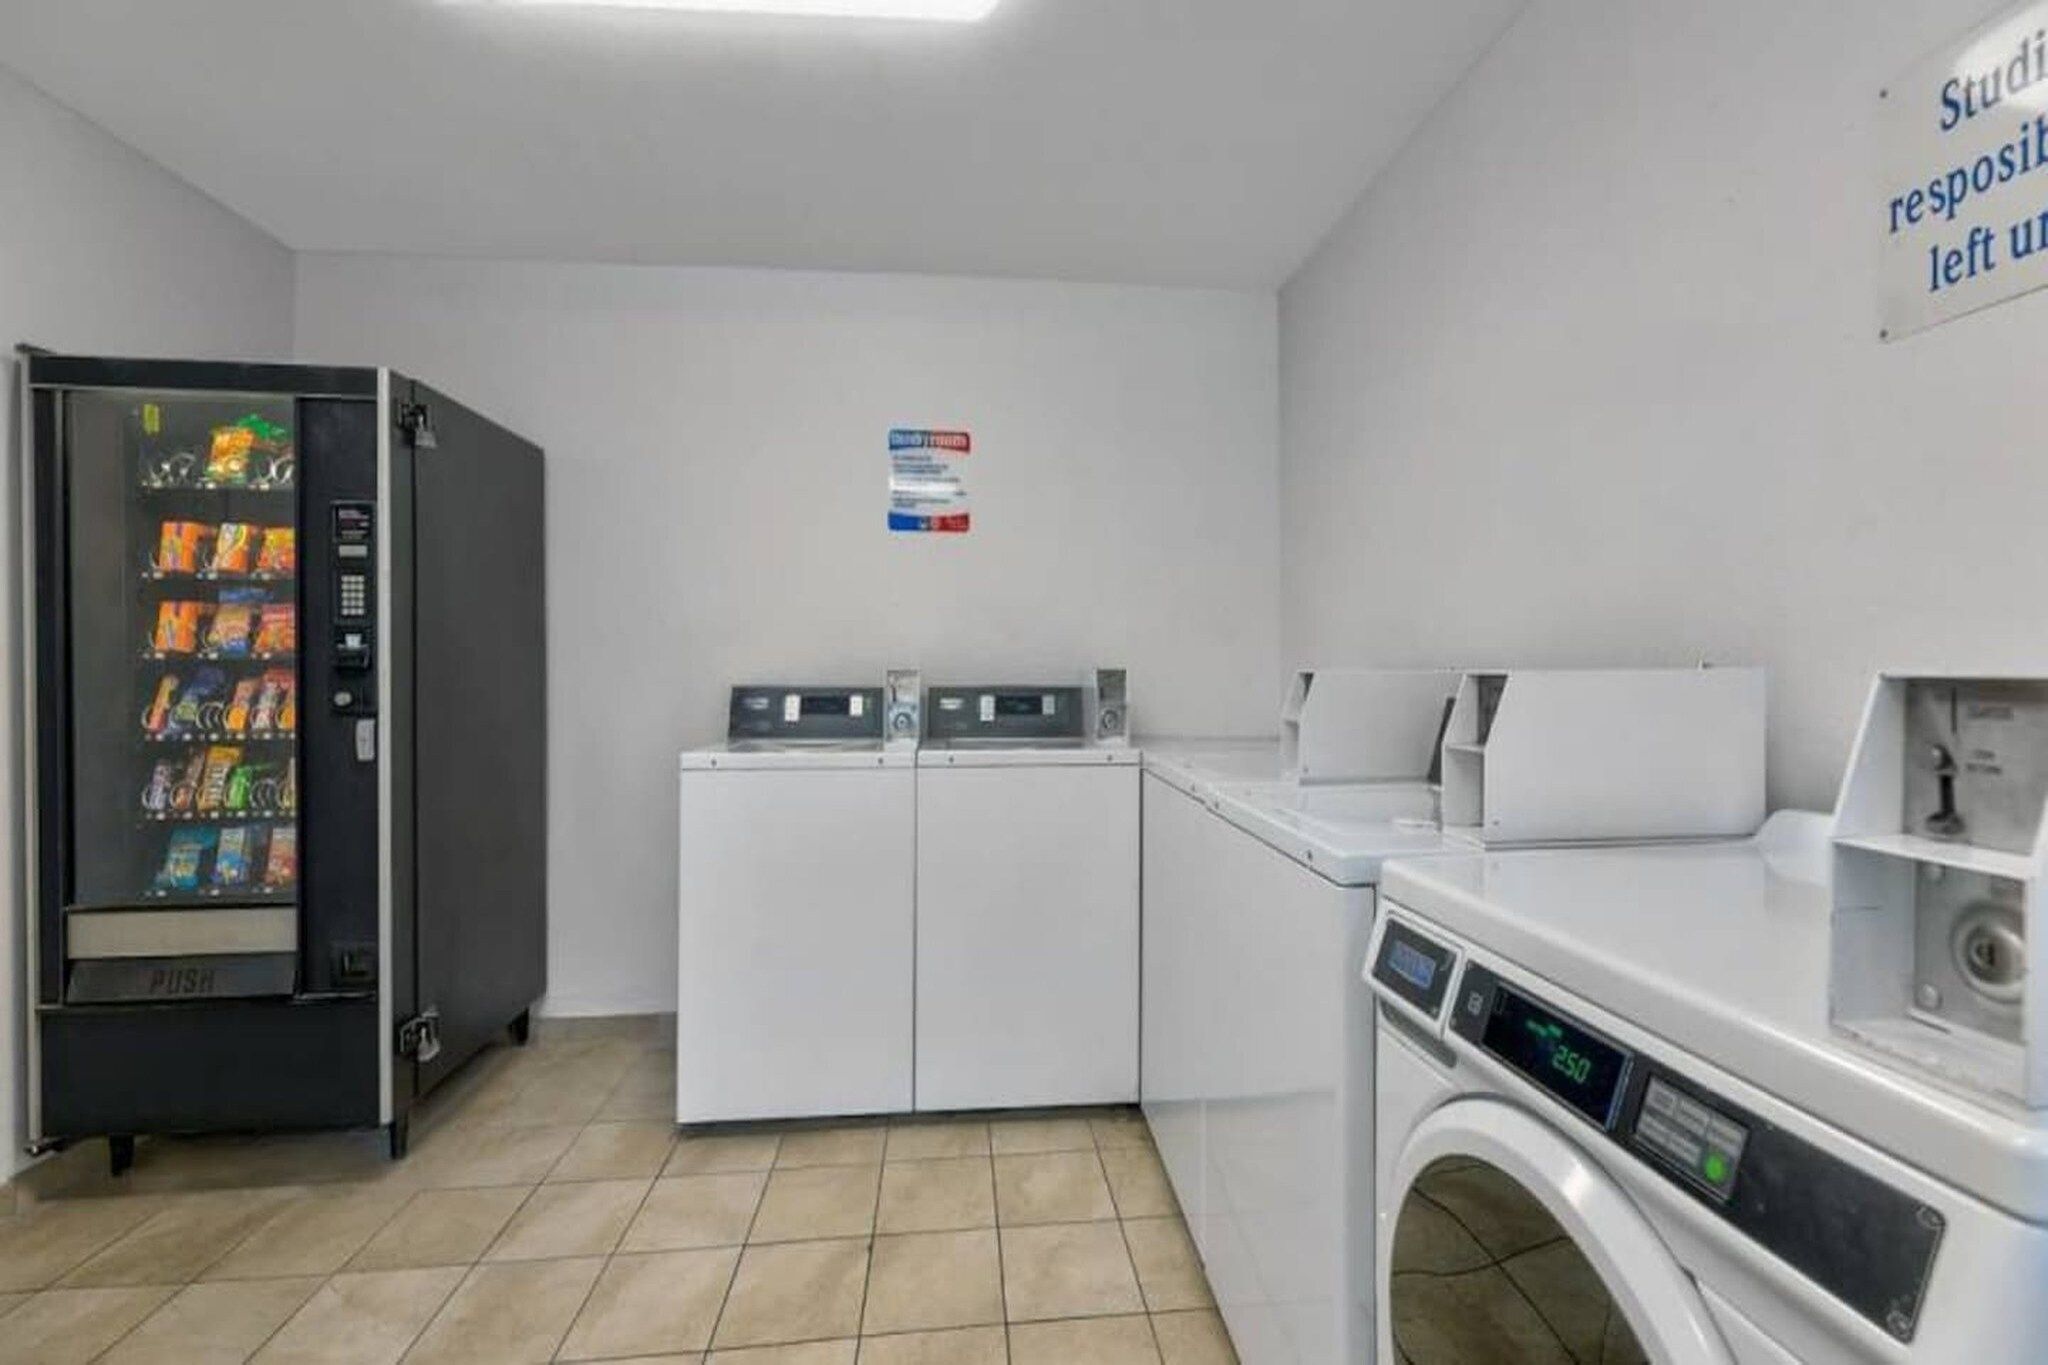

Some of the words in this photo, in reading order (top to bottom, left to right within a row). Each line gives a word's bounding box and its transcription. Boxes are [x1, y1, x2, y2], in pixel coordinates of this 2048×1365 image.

[1940, 29, 2048, 131] Studi
[1929, 226, 1996, 292] left
[149, 968, 216, 994] PUSH
